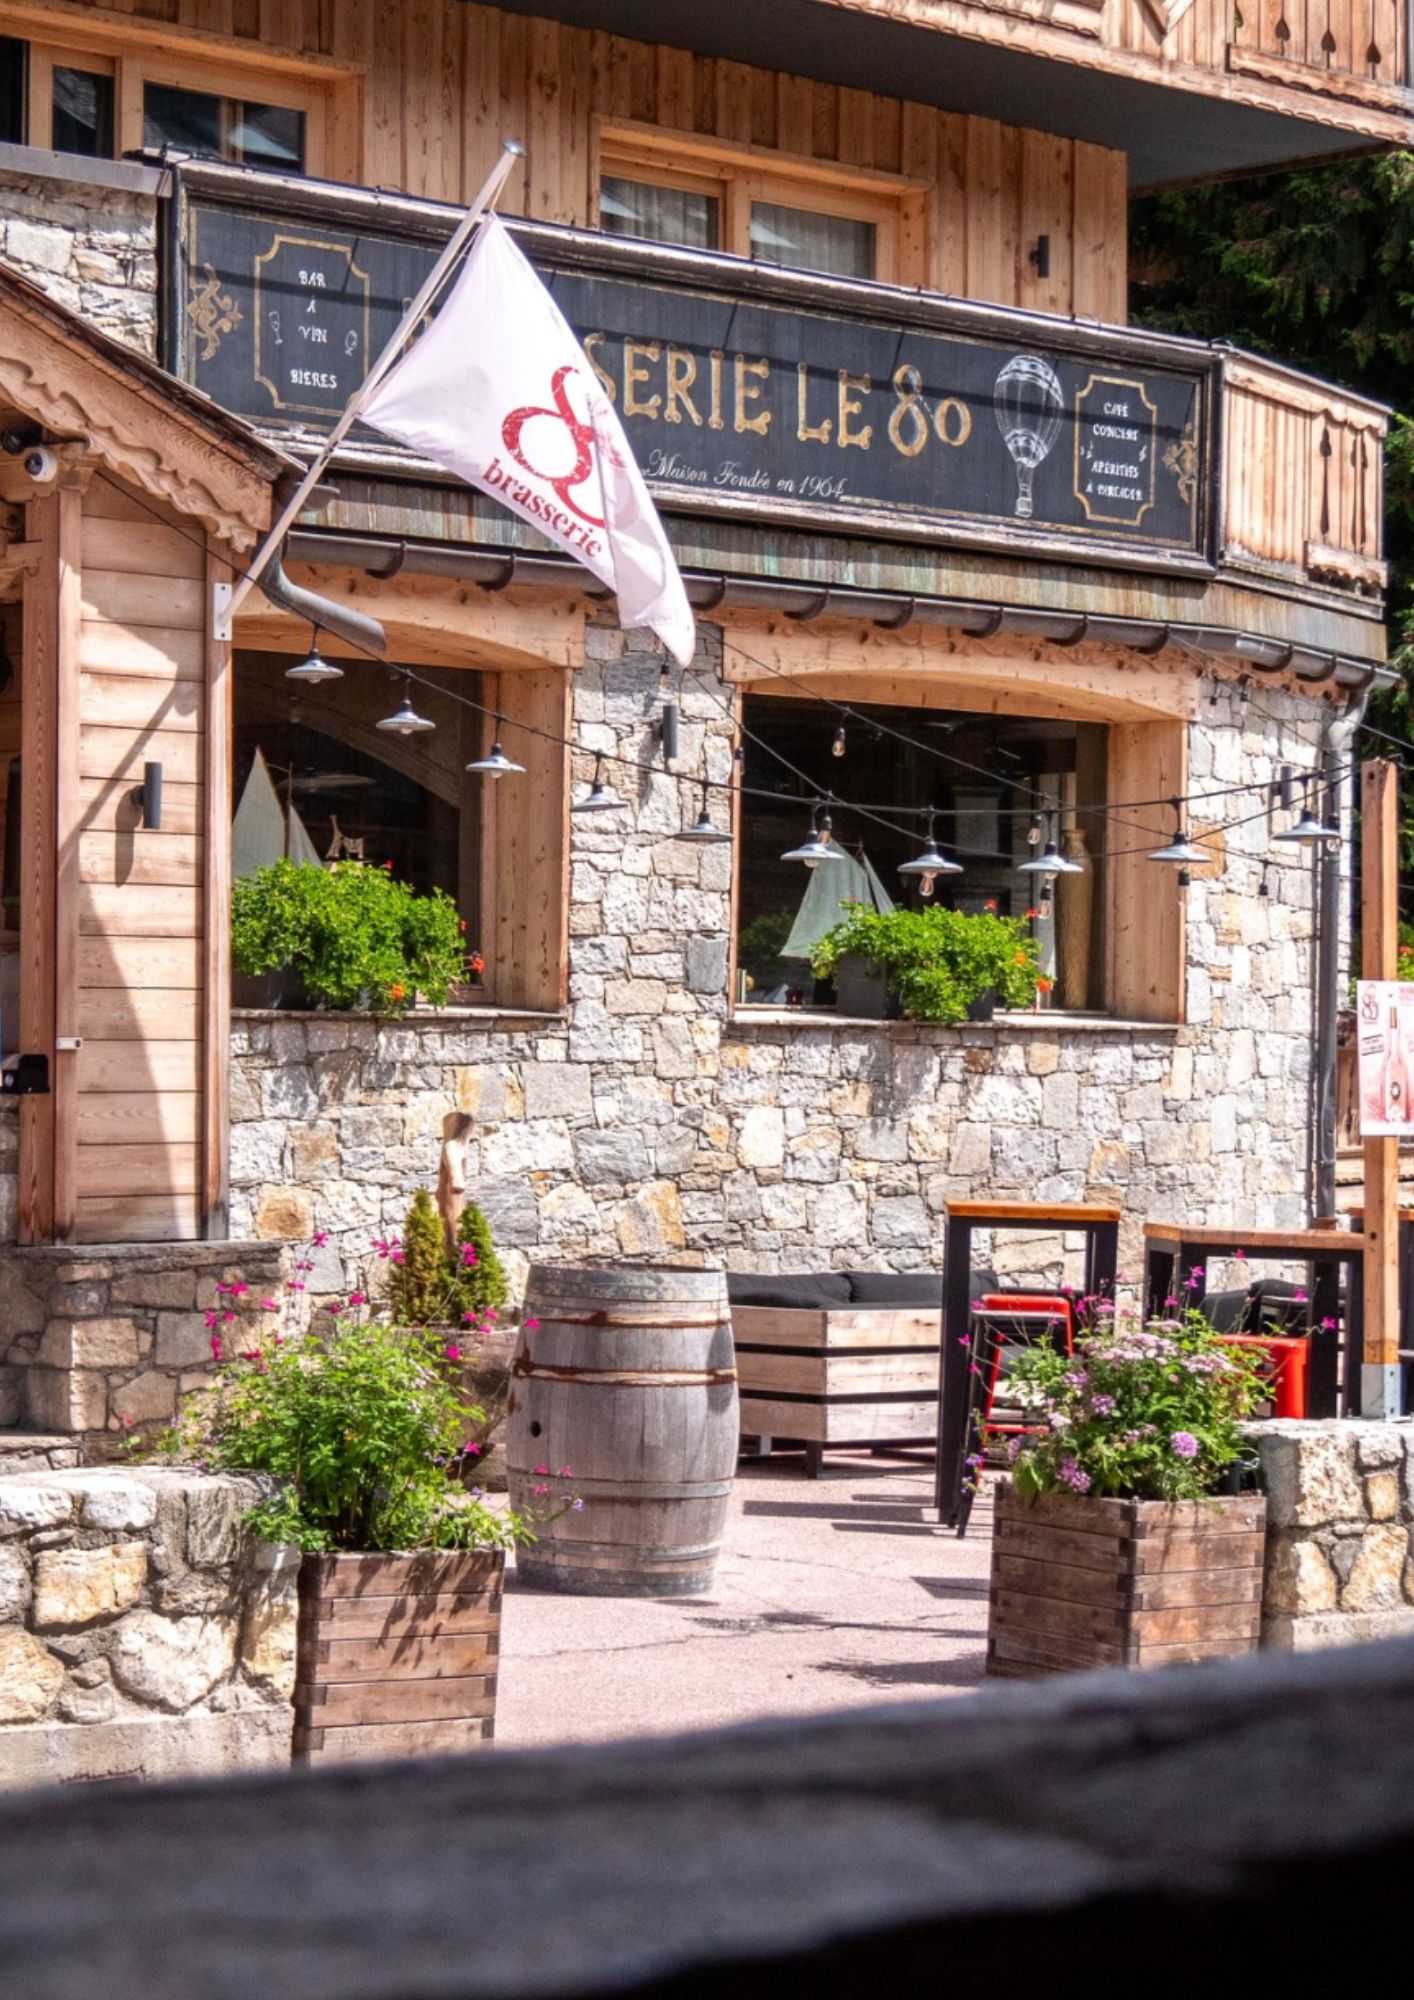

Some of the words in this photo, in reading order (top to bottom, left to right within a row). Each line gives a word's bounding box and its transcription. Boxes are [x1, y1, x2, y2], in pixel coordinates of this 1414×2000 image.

[298, 270, 326, 288] BAR
[298, 325, 328, 344] VIN
[796, 362, 873, 450] LE
[888, 363, 973, 457] 80
[1093, 424, 1139, 441] CONCERT
[647, 449, 709, 482] Maison
[713, 460, 771, 490] Fondée
[777, 479, 796, 492] en
[481, 457, 603, 558] brasserie
